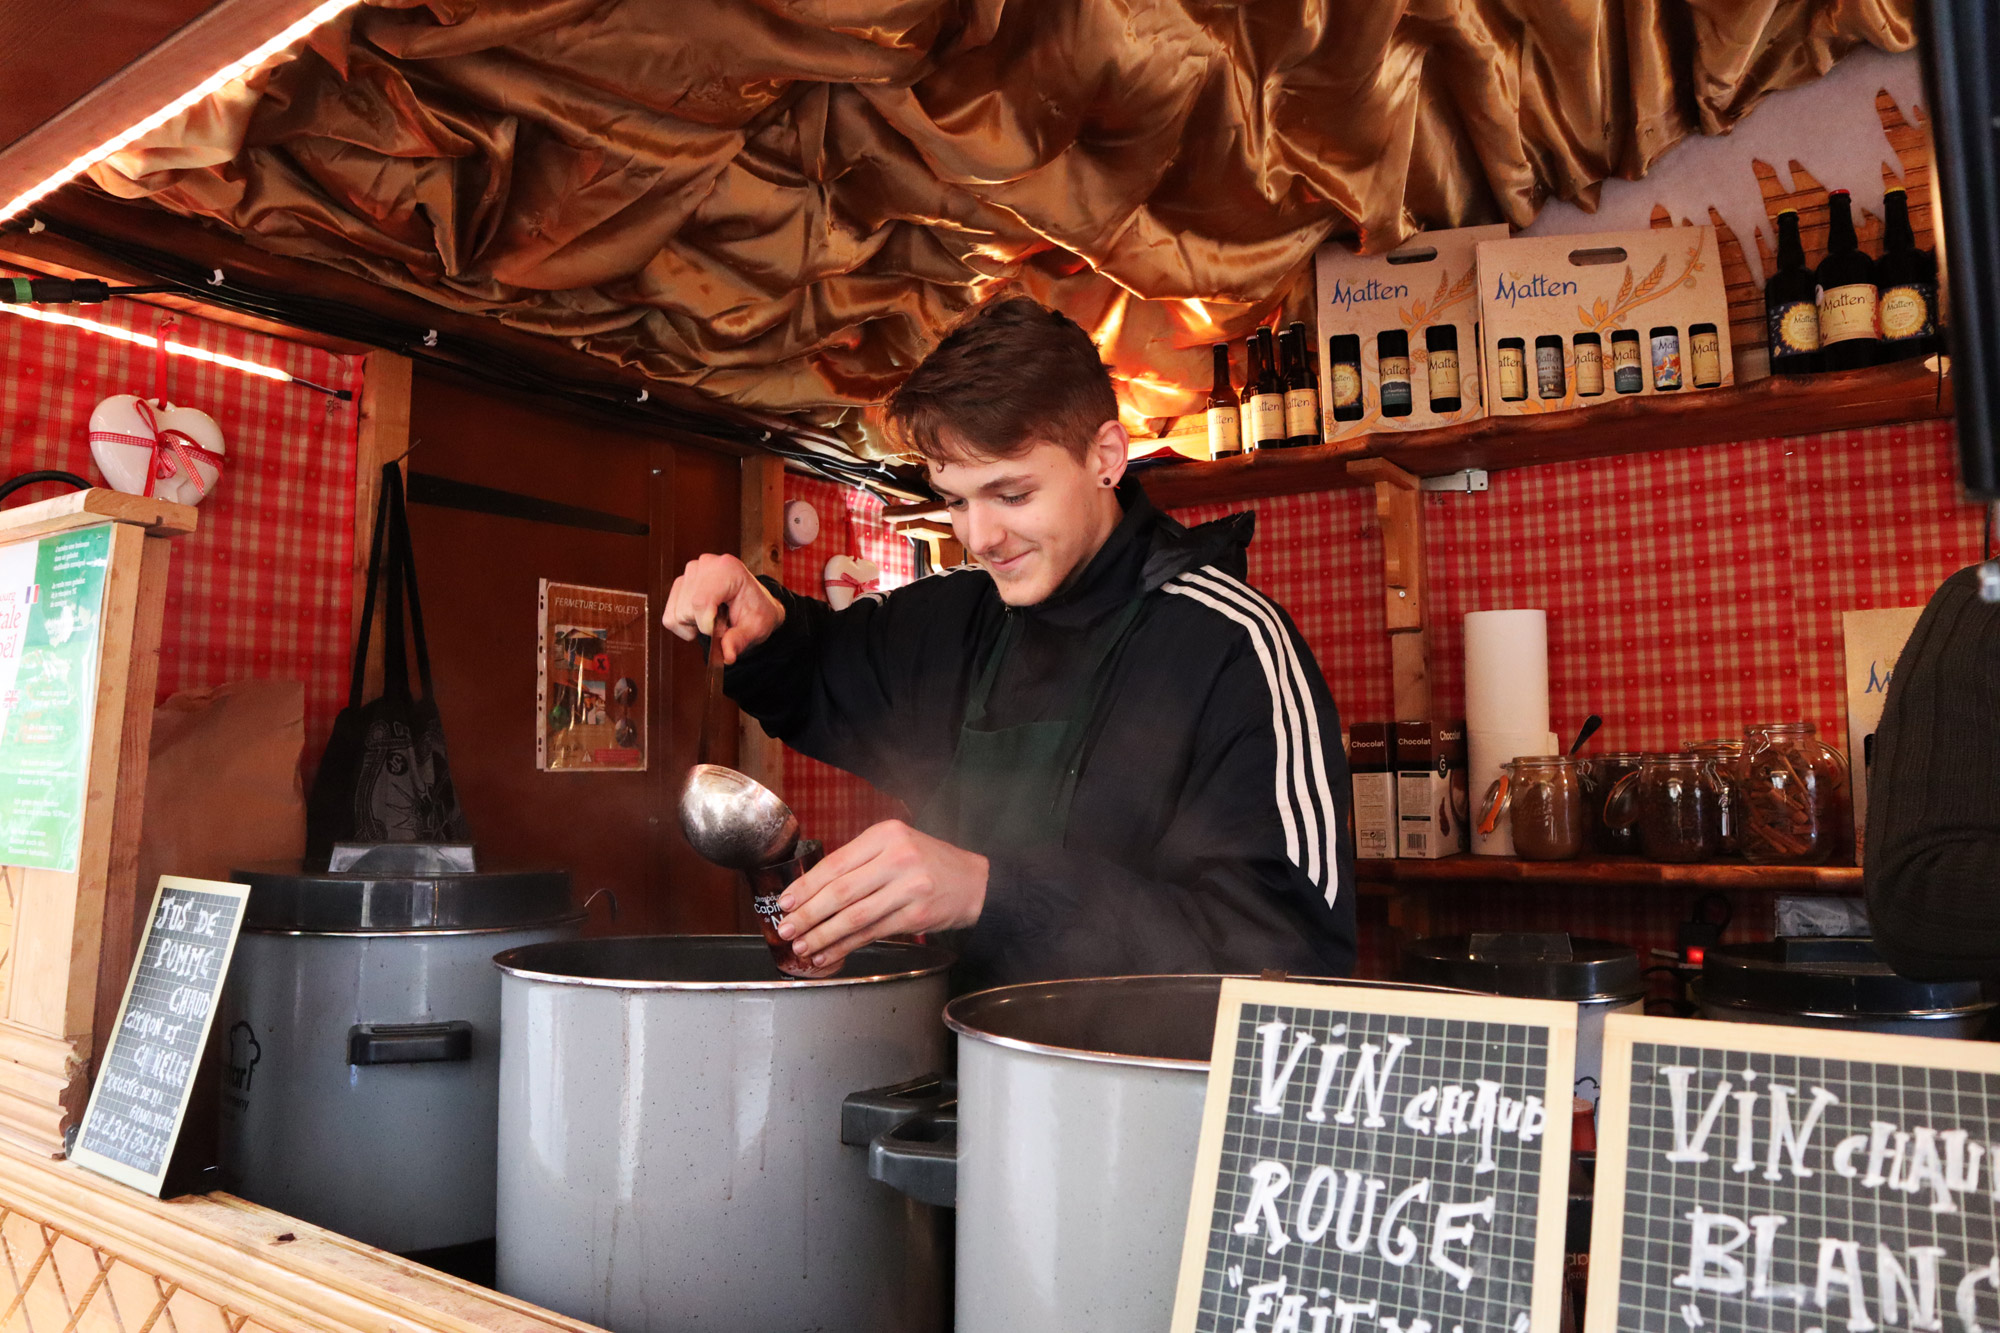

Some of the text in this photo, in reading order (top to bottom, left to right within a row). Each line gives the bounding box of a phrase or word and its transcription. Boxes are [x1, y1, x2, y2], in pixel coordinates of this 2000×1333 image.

[1331, 278, 1408, 312] Matten
[1494, 272, 1577, 309] Matten
[1823, 293, 1866, 314] Matten
[1886, 299, 1916, 312] Matten
[1692, 341, 1720, 358] Matt
[1429, 356, 1461, 375] Matte
[1498, 355, 1522, 369] atten
[1256, 400, 1281, 413] atten
[1286, 397, 1311, 410] atten
[554, 596, 640, 616] FERMETURE DES VOLETS
[1351, 739, 1385, 749] Chocolat
[1398, 737, 1432, 746] Chocolat
[155, 895, 221, 939] JUS DE
[154, 938, 217, 983] POMME
[168, 984, 211, 1023] CHAUD
[163, 1023, 184, 1045] ET
[1402, 1078, 1548, 1173] CHAUD
[1233, 1158, 1496, 1291] ROUGE
[1672, 1205, 2000, 1333] BLANC
